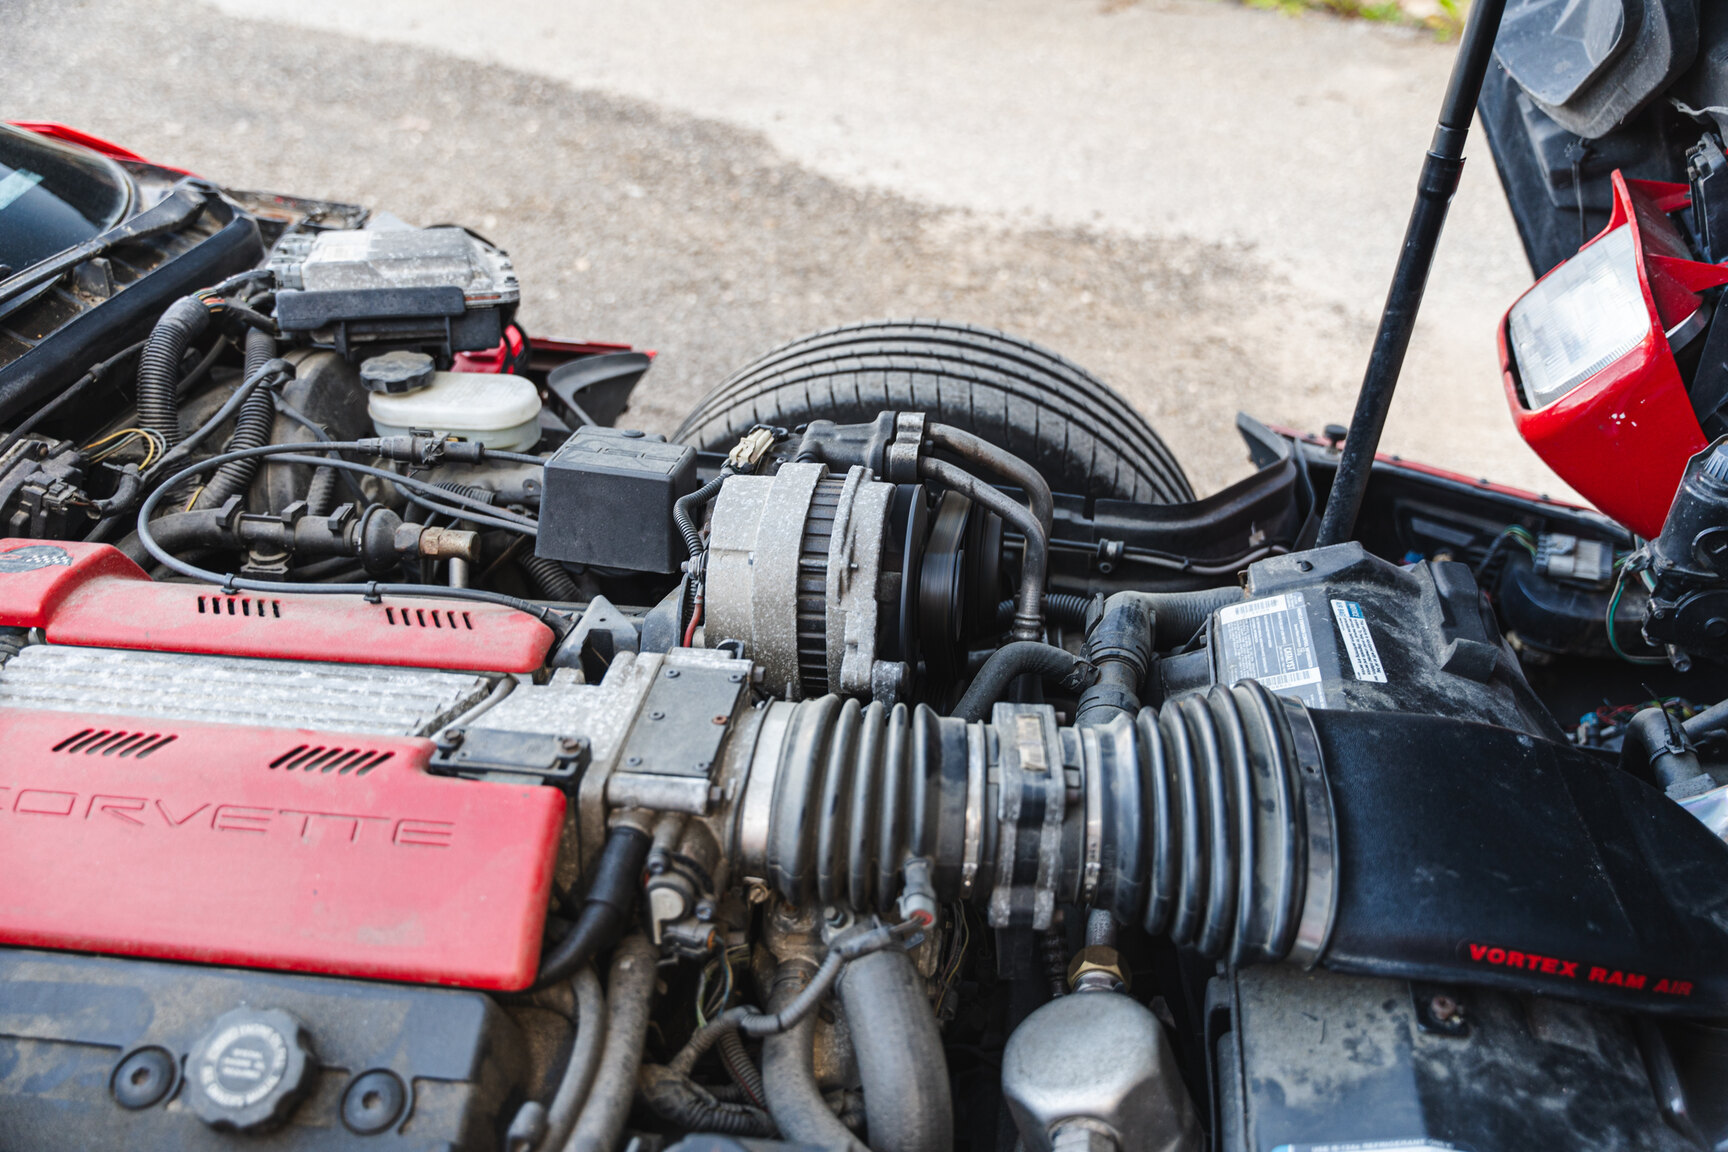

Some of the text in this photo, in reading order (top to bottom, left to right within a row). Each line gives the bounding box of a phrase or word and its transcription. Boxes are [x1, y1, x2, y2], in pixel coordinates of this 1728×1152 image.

[1282, 646, 1295, 671] CATALYST
[0, 787, 455, 847] ORVETTE
[1469, 943, 1694, 996] VORTEX RAM AIR
